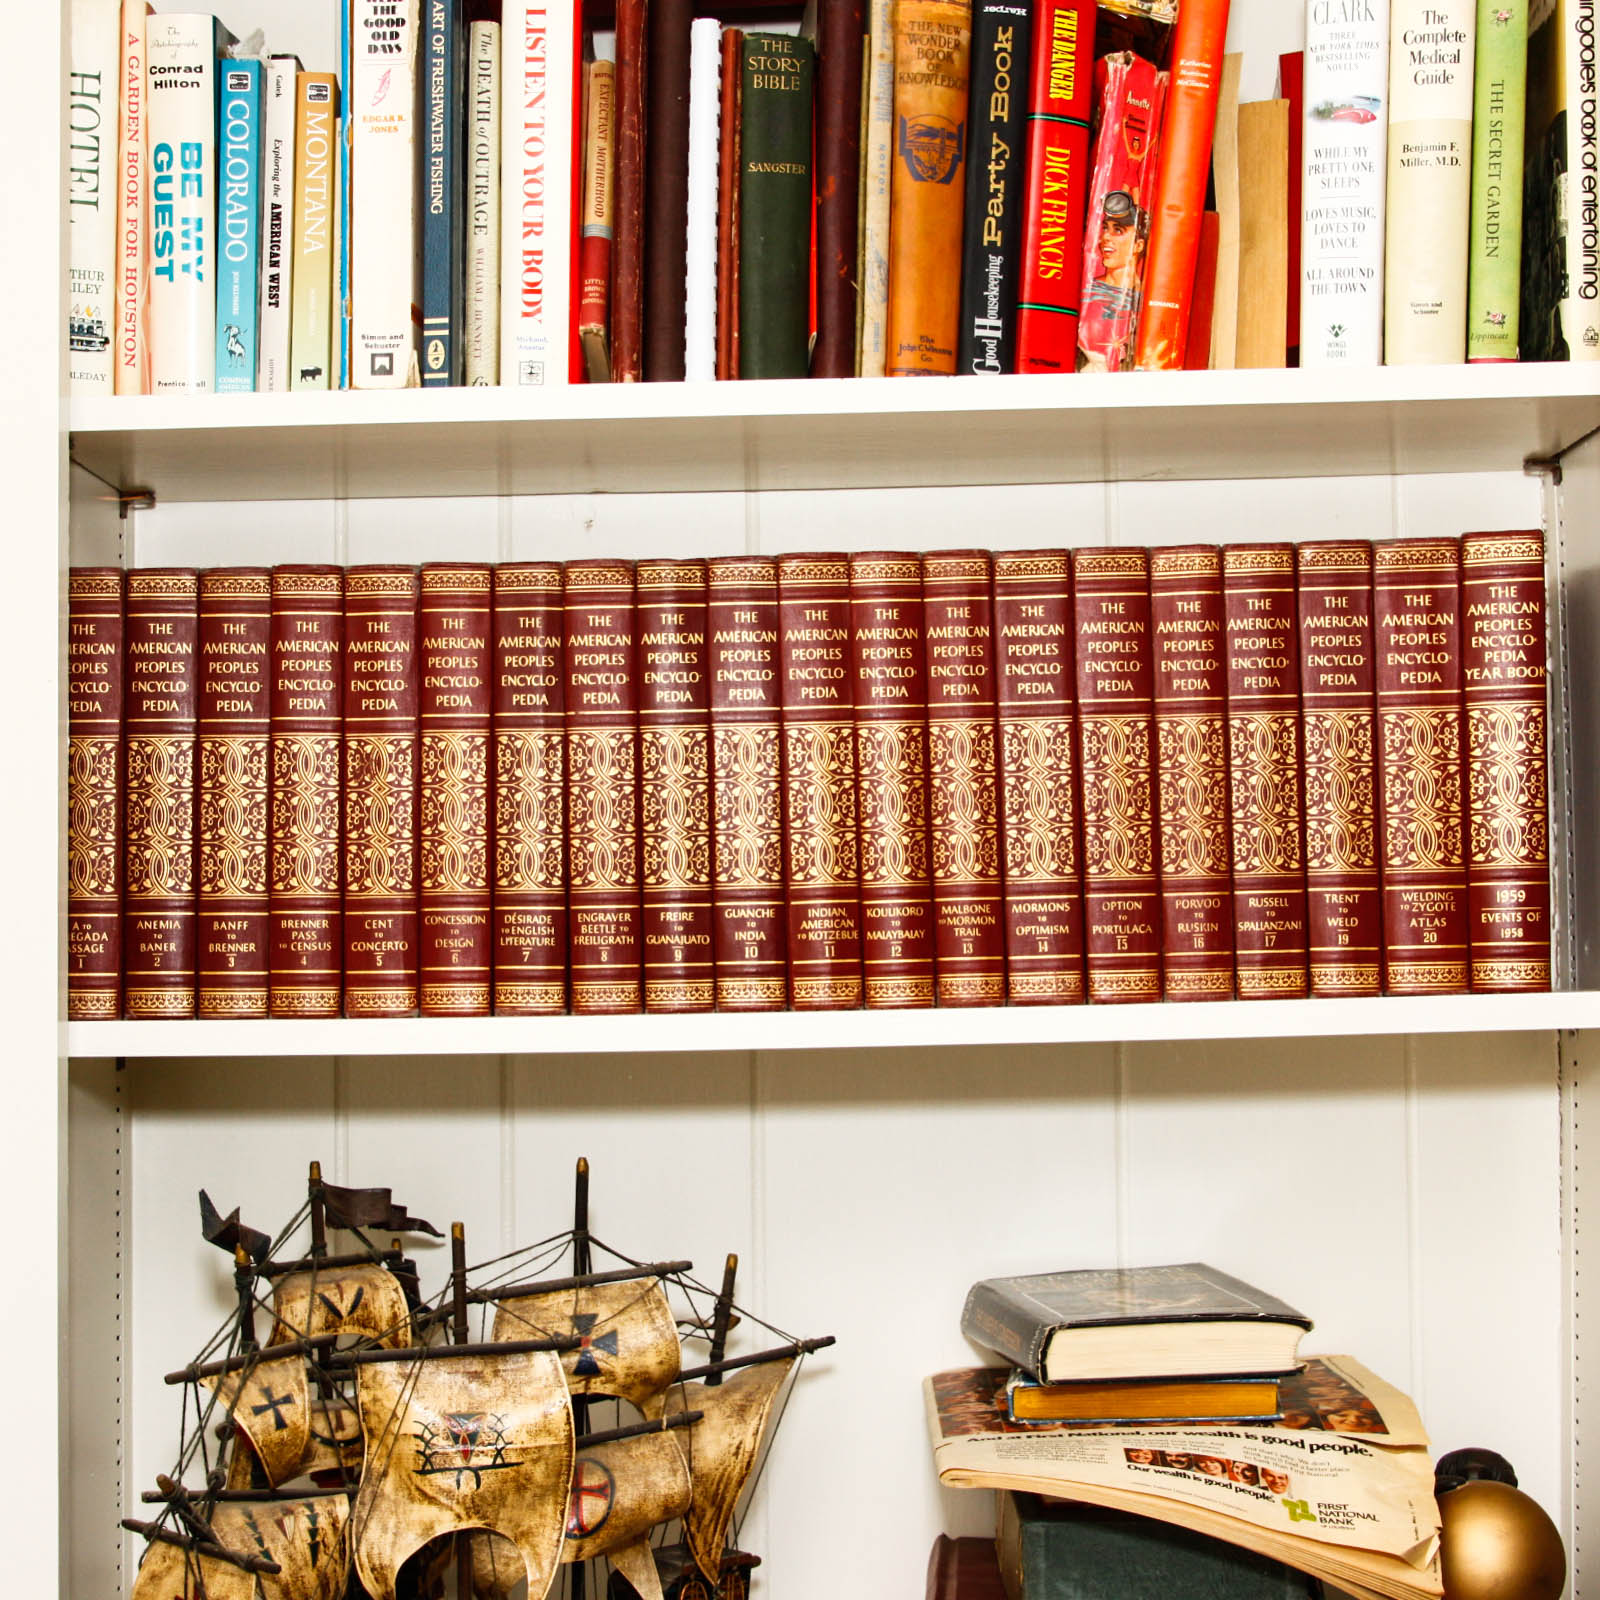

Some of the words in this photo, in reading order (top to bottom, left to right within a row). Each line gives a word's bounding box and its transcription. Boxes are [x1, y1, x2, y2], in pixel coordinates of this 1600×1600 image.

[373, 5, 396, 15] THE
[432, 1, 445, 31] ART
[983, 6, 1027, 16] Harper
[1314, 0, 1375, 26] CLARK
[363, 17, 406, 28] GOOD
[1053, 8, 1078, 41] THE
[1422, 10, 1449, 26] The
[910, 20, 933, 32] THE
[938, 23, 961, 36] NEW
[127, 32, 140, 47] A
[371, 31, 400, 41] OLD
[908, 33, 961, 50] WONDER
[1403, 30, 1466, 47] Complete
[367, 43, 402, 54] DAYS
[432, 34, 445, 55] OF
[480, 32, 492, 55] The
[762, 39, 793, 53] THE
[524, 8, 547, 108] LISTEN
[917, 47, 954, 64] BOOK
[1409, 50, 1461, 66] Medical
[149, 64, 203, 75] Conrad
[748, 57, 805, 72] STORY
[1049, 40, 1076, 100] DANGER
[990, 26, 1013, 122] Book
[1414, 70, 1454, 86] Guide
[154, 80, 200, 89] Hilton
[752, 75, 800, 91] BIBLE
[477, 60, 492, 123] DEATH
[1489, 80, 1505, 115] THE
[127, 55, 140, 143] GARDEN
[431, 59, 445, 153] FRESHWATER
[362, 114, 396, 124] EDGAR
[599, 83, 612, 144] EXPECTANT
[369, 125, 399, 134] JONES
[1580, 100, 1597, 147] book
[479, 127, 489, 138] of
[524, 117, 545, 158] TO
[1314, 147, 1351, 159] WHILE
[1352, 146, 1369, 158] MY
[1402, 143, 1447, 154] Benjamin
[1449, 142, 1459, 153] F.
[1488, 121, 1503, 180] SECRET
[273, 138, 282, 182] Exploring
[1435, 156, 1461, 167] M.D.
[1581, 152, 1597, 173] of
[180, 142, 203, 199] BE
[748, 162, 806, 175] SANGSTER
[1043, 145, 1070, 196] DICK
[1308, 163, 1349, 176] PRETTY
[1352, 162, 1375, 173] ONE
[126, 151, 139, 209] BOOK
[225, 99, 250, 262] COLORADO
[303, 111, 329, 255] MONTANA
[431, 157, 443, 215] FISHING
[594, 146, 607, 218] MOTHERHOOD
[1320, 176, 1361, 190] SLEEPS
[272, 184, 281, 198] the
[473, 143, 490, 235] OUTRAGE
[983, 133, 1010, 247] Party
[522, 164, 545, 240] YOUR
[153, 142, 174, 283] GUEST
[1305, 209, 1339, 222] LOVES
[1340, 207, 1376, 221] MUSIC,
[1314, 223, 1349, 236] LOVES
[1351, 222, 1366, 233] TO
[1485, 185, 1501, 259] GARDEN
[126, 218, 139, 255] FOR
[269, 202, 282, 268] AMERICAN
[1038, 198, 1067, 280] FRANCIS
[1578, 175, 1599, 300] entertaining
[179, 217, 204, 283] MY
[1320, 237, 1358, 249] DANCE
[1306, 269, 1326, 281] ALL
[1328, 267, 1375, 280] AROUND
[268, 273, 279, 308] WEST
[520, 249, 544, 324] BODY
[1310, 284, 1332, 296] THE
[1333, 282, 1367, 294] TOWN
[973, 255, 1004, 340] Housekeeping
[123, 266, 138, 368] HOUSTON
[1470, 333, 1509, 342] Lippincott
[972, 339, 1001, 377] Good
[1488, 586, 1518, 599] THE
[1467, 602, 1539, 617] AMERICAN
[733, 611, 759, 624] THE
[148, 623, 173, 635] THE
[1474, 618, 1532, 632] PEOPLES
[713, 630, 777, 644] AMERICAN
[129, 642, 193, 655] AMERICAN
[720, 649, 771, 663] PEOPLES
[1484, 649, 1526, 663] PEDIA
[135, 662, 185, 674] PEOPLES
[1464, 667, 1503, 680] YEAR
[1507, 665, 1547, 678] BOOK
[728, 688, 766, 701] PEDIA
[142, 700, 179, 712] PEDIA
[1324, 894, 1360, 904] TRENT
[1496, 890, 1526, 904] 1959
[1101, 900, 1143, 911] OPTION
[724, 908, 776, 919] GUANCHE
[1481, 911, 1522, 924] EVENTS
[1526, 912, 1542, 922] OF
[136, 920, 181, 930] ANEMIA
[364, 919, 393, 930] CENT
[1092, 924, 1152, 935] PORTULACA
[1326, 917, 1358, 928] WELD
[734, 930, 766, 941] INDIA
[1337, 933, 1349, 945] 19
[1500, 928, 1524, 939] 1958
[140, 942, 177, 953] BANER
[351, 941, 409, 952] CONCERTO
[1117, 938, 1128, 951] 15
[744, 946, 758, 958] 10
[153, 956, 161, 967] 2
[376, 955, 383, 967] 5
[1029, 1432, 1063, 1440] First
[1066, 1430, 1150, 1439] National,
[1186, 1429, 1241, 1440] wealth
[1244, 1431, 1258, 1440] is
[1262, 1436, 1305, 1452] good
[1309, 1441, 1373, 1457] people.
[1127, 1464, 1151, 1474] Our
[1154, 1466, 1191, 1480] wealth
[1193, 1473, 1202, 1481] is
[1204, 1478, 1233, 1493] good
[1316, 1502, 1349, 1511] FIRST
[1318, 1509, 1380, 1522] NATIONAL
[1319, 1516, 1355, 1526] BANK
